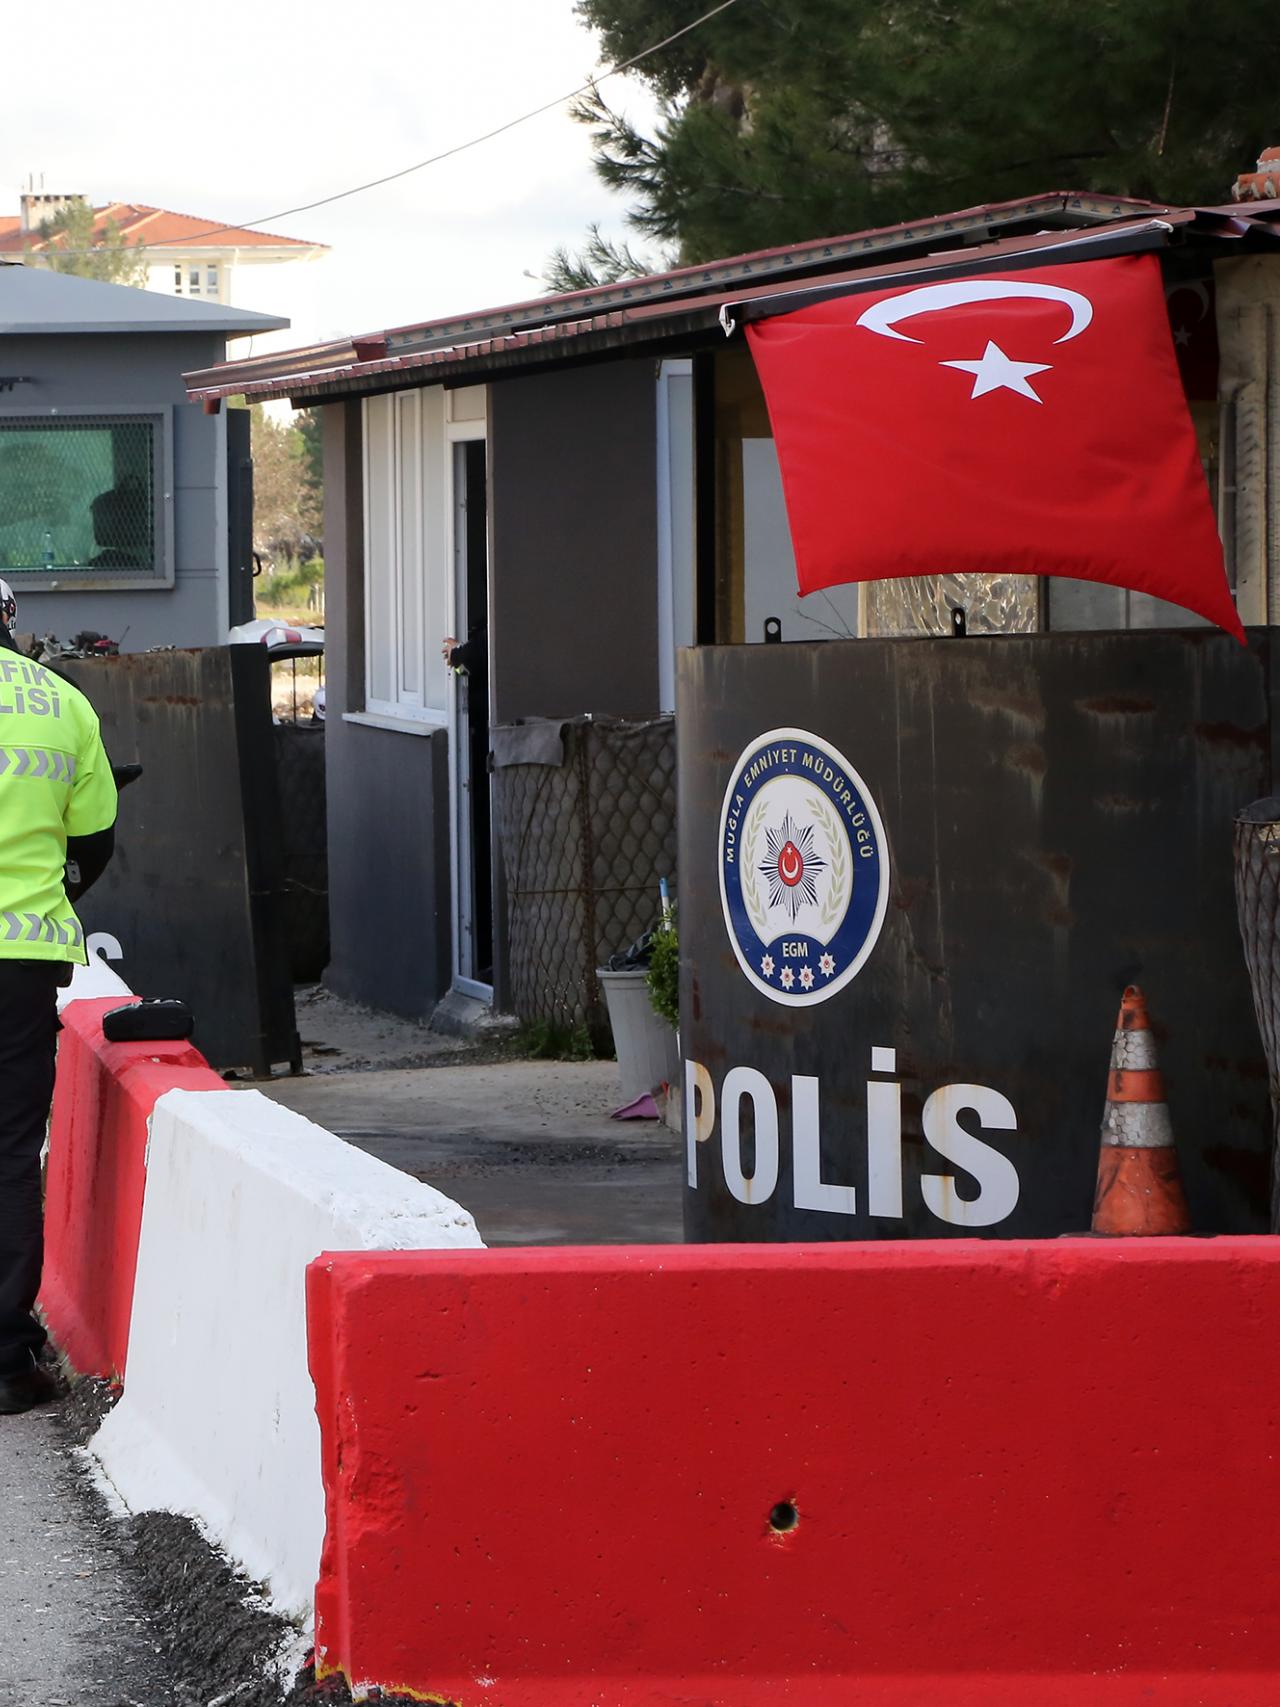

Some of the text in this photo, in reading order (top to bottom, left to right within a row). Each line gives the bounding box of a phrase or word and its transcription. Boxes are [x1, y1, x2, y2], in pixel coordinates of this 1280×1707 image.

[726, 748, 875, 863] MUĞLA EMNİYET MÜDÜRLÜĞÜ
[782, 942, 809, 958] EGM
[685, 1046, 1020, 1227] POLİS
